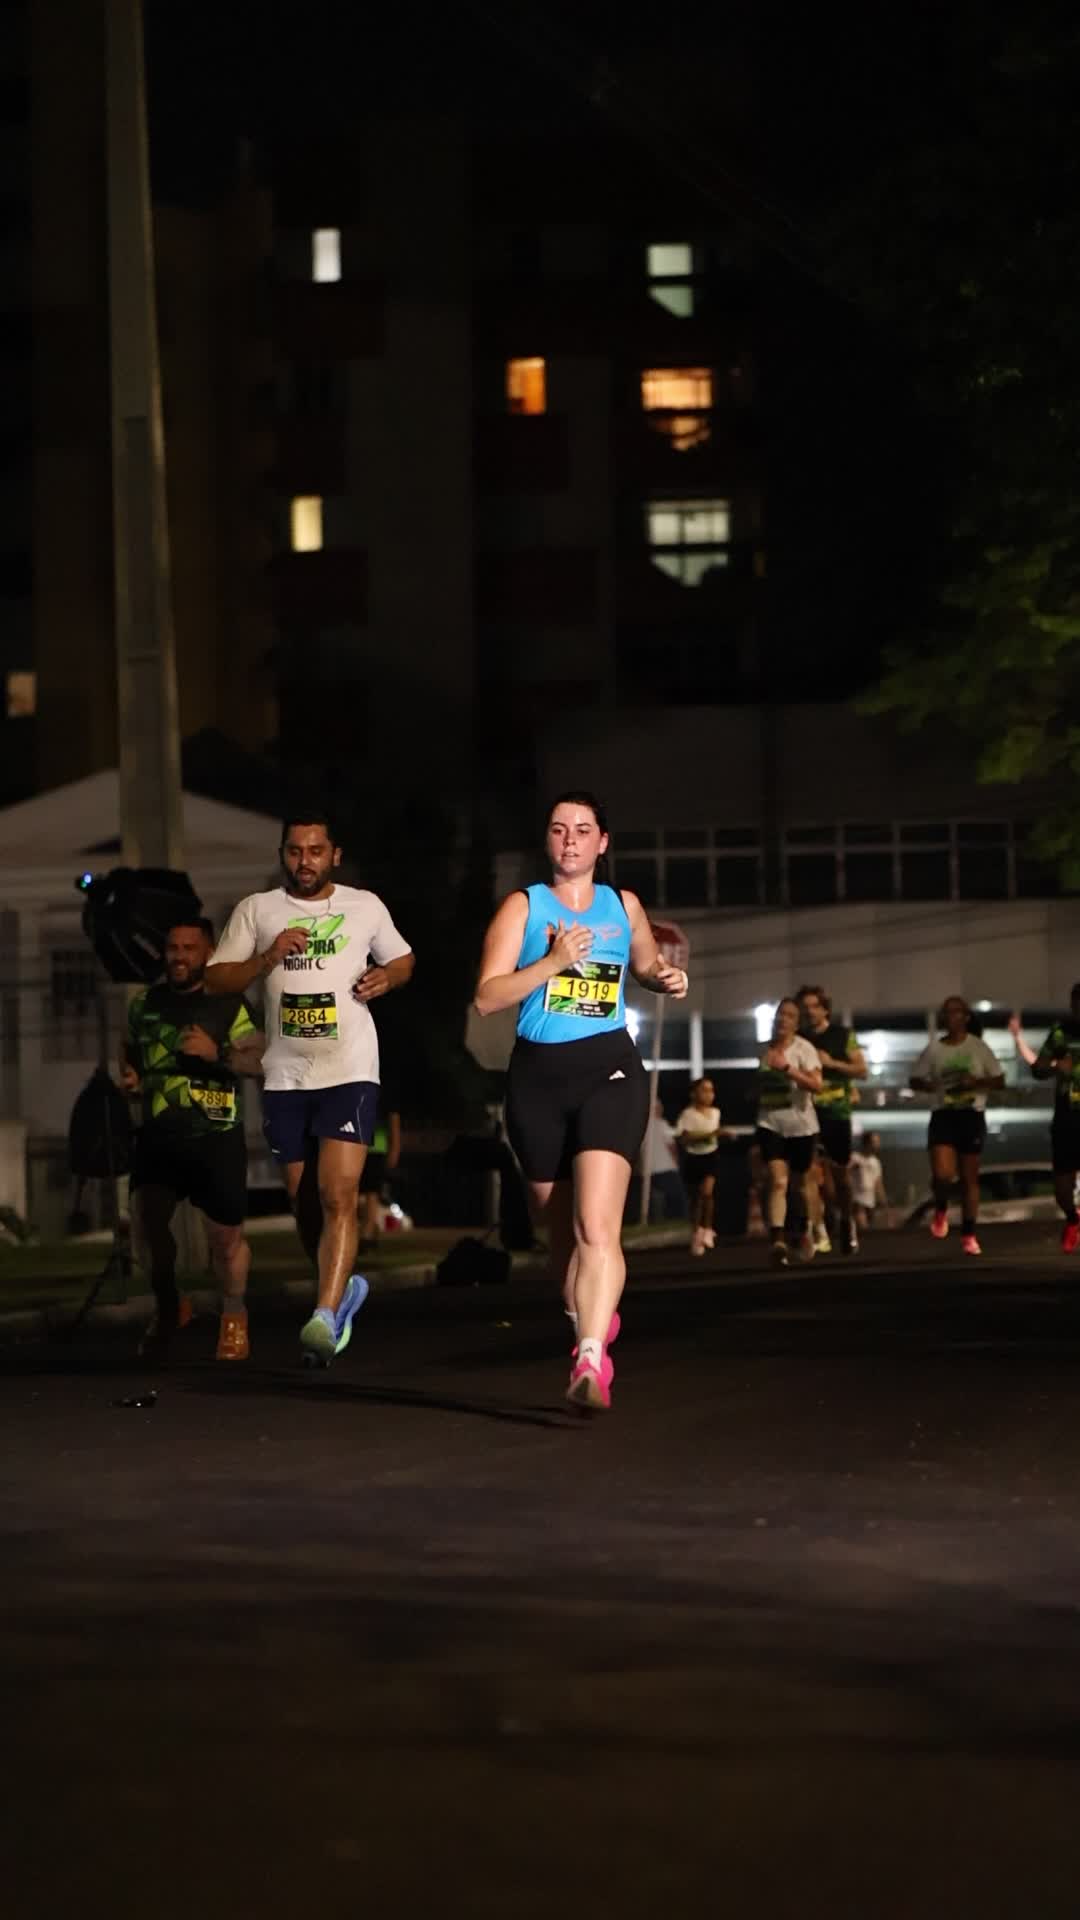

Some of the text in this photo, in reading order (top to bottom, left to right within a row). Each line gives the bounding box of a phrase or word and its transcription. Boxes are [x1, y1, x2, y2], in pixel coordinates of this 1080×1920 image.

[300, 939, 336, 955] PIRA
[283, 957, 314, 971] NIGHT
[566, 979, 610, 1001] 1919
[288, 1008, 327, 1025] 2864
